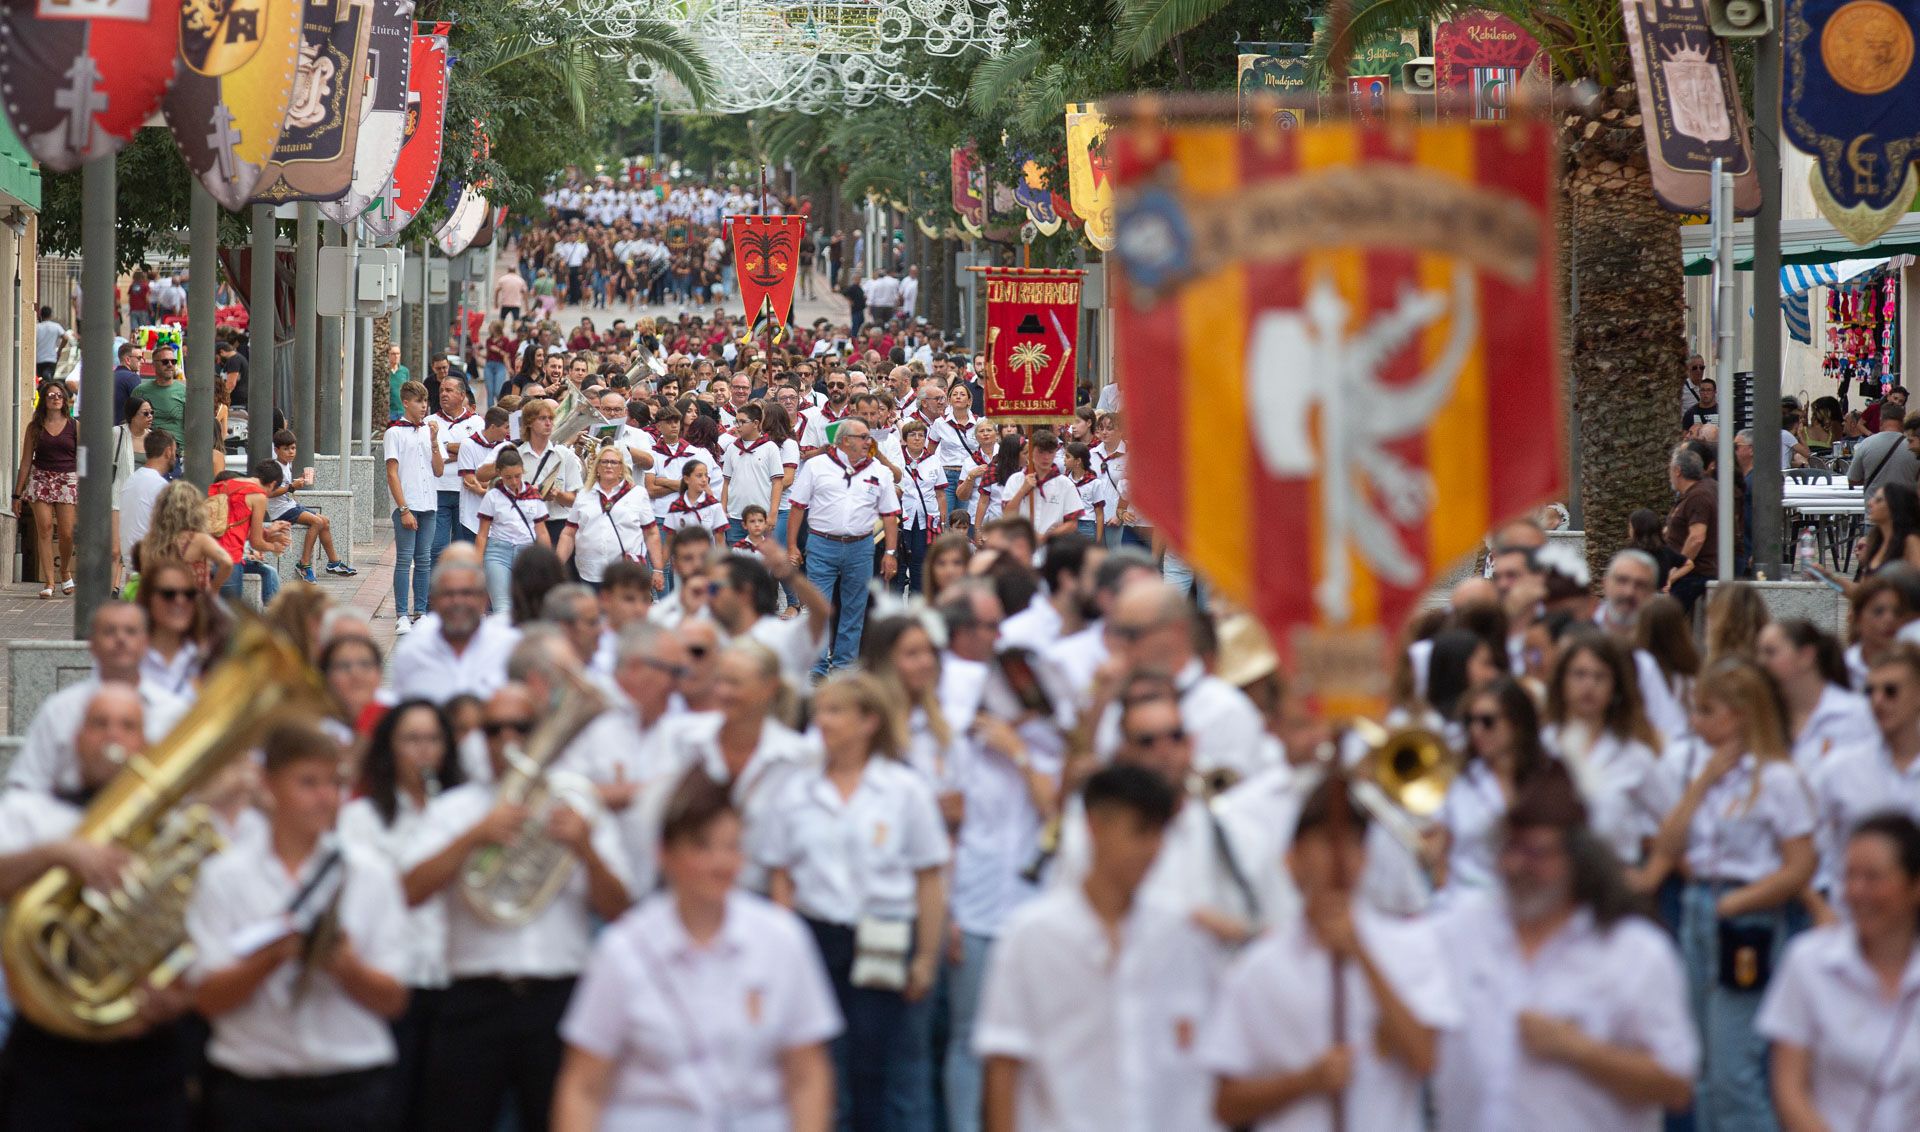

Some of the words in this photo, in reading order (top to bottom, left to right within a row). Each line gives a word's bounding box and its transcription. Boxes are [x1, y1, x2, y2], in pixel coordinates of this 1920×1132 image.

[1467, 25, 1517, 43] Kabileños
[1264, 72, 1304, 90] Mudéjares
[986, 280, 1079, 304] CONTRABANDO
